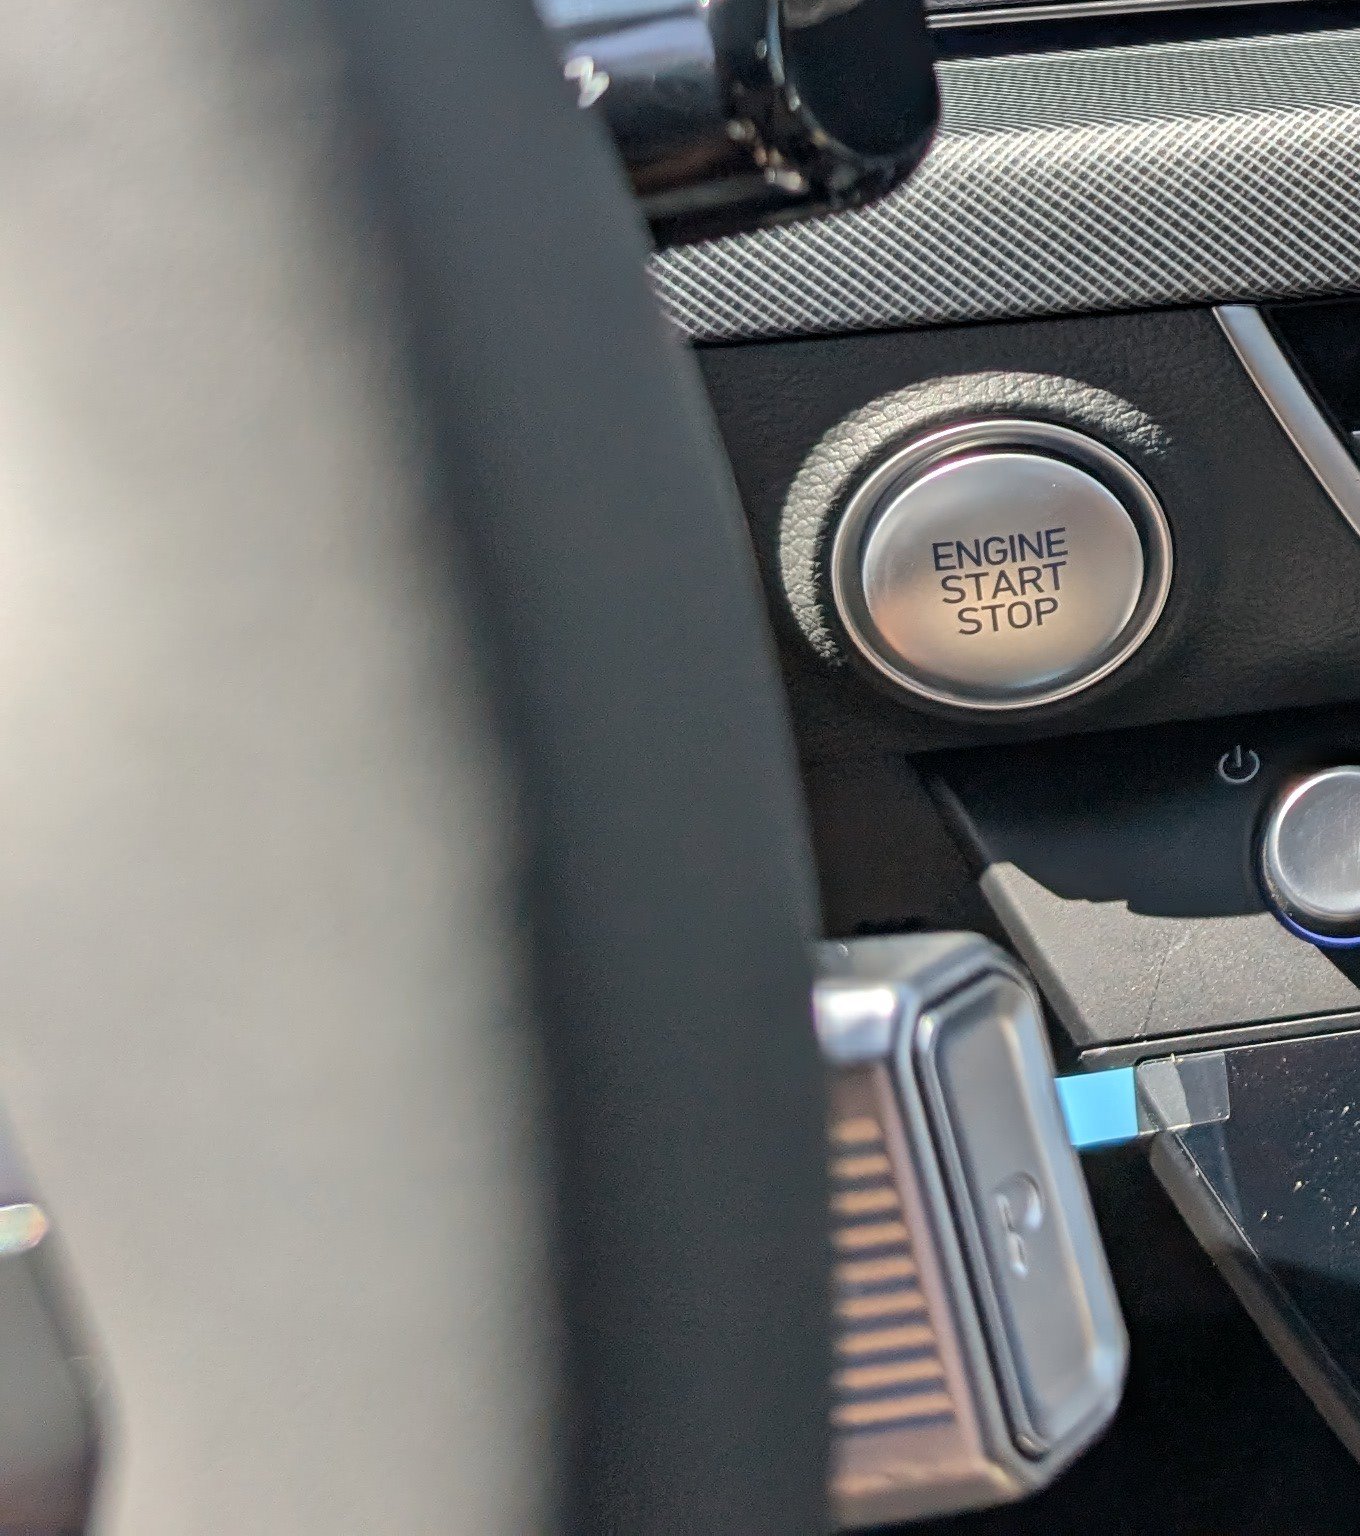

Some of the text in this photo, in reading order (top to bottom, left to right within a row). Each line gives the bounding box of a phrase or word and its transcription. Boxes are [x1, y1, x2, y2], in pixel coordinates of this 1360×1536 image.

[932, 527, 1069, 572] ENGINE
[940, 560, 1068, 605] START
[957, 597, 1060, 636] STOP
